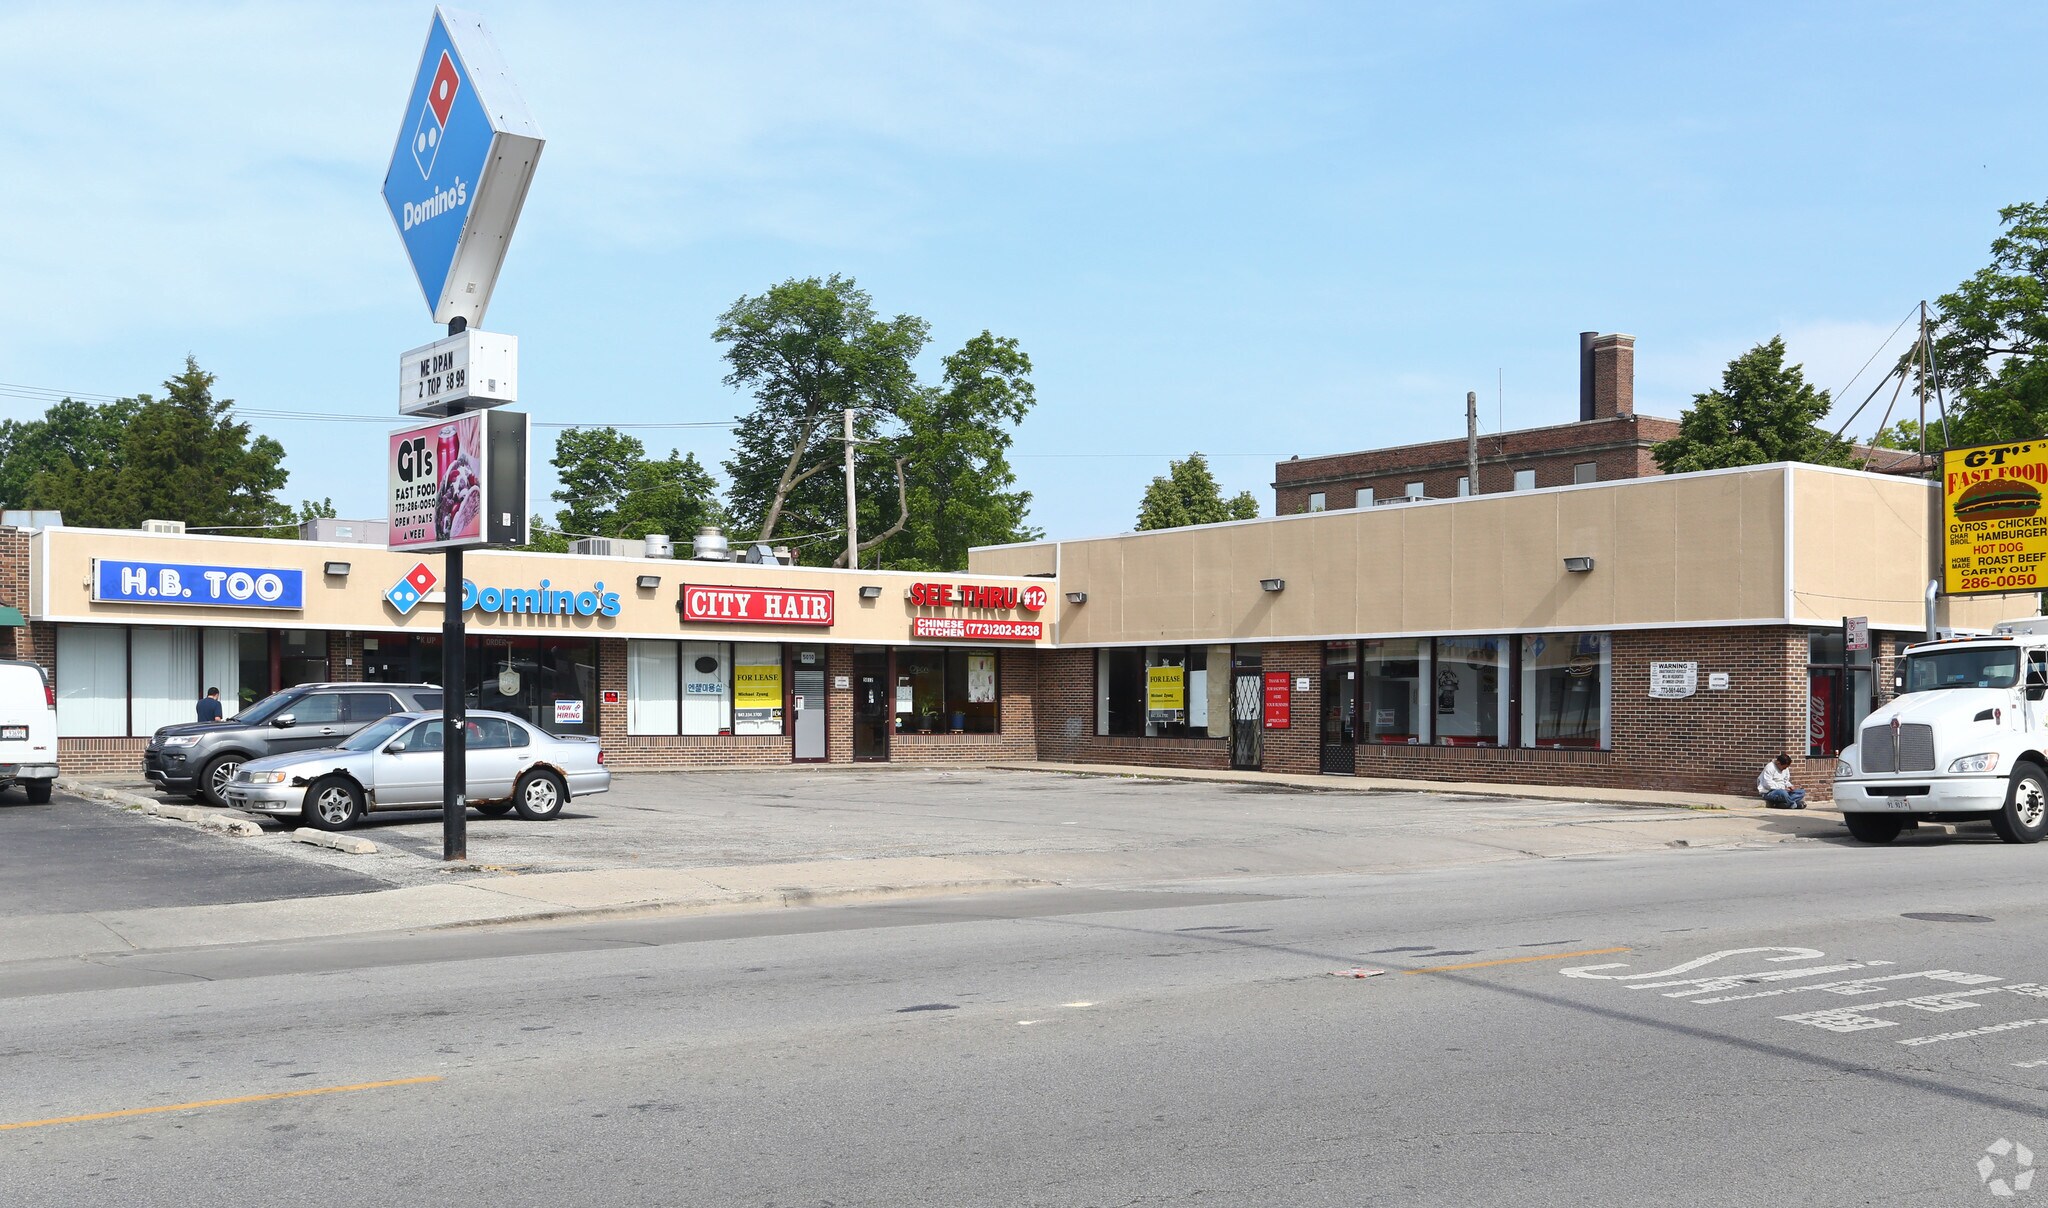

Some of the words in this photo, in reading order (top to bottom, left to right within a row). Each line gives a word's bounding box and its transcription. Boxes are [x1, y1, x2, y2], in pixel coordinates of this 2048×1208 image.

[403, 176, 467, 232] Domino's
[420, 359, 430, 377] ME
[418, 381, 424, 398] 2
[427, 377, 441, 396] TOP
[398, 437, 433, 483] GTs
[1964, 445, 2031, 468] GT's
[1947, 468, 1993, 496] FAST
[1998, 463, 2048, 485] FOOD
[395, 486, 414, 501] FAST
[417, 483, 436, 497] FOOD
[395, 498, 436, 513] 773-286-0050
[394, 515, 410, 527] OPEN
[412, 515, 416, 524] 7
[418, 513, 433, 524] DAYS
[1950, 522, 1988, 533] GYROS
[1997, 516, 2047, 530] CHICKEN
[403, 531, 408, 540] A
[410, 529, 425, 539] WEEK
[1977, 527, 2048, 541] HAMBURGER
[1973, 544, 1996, 555] HOT
[1999, 542, 2024, 553] DOG
[1978, 555, 2015, 566] ROAST
[2018, 552, 2047, 563] BEEF
[1961, 567, 2006, 576] CARRY
[2009, 565, 2038, 573] OUT
[121, 566, 192, 597] H.B.
[203, 571, 284, 602] TOO
[1961, 574, 2037, 590] 286-0050
[911, 582, 953, 608] SEE
[959, 585, 1018, 610] THRU
[1023, 590, 1046, 607] #12
[691, 591, 751, 617] CITY
[764, 594, 828, 620] HAIR
[917, 618, 964, 629] CHINESE
[966, 623, 1040, 637] (773)202-8238
[917, 627, 965, 637] KITCHEN
[486, 638, 507, 646] ORDER
[1163, 675, 1181, 683] LEASE
[687, 683, 723, 693] 엔젤미용실
